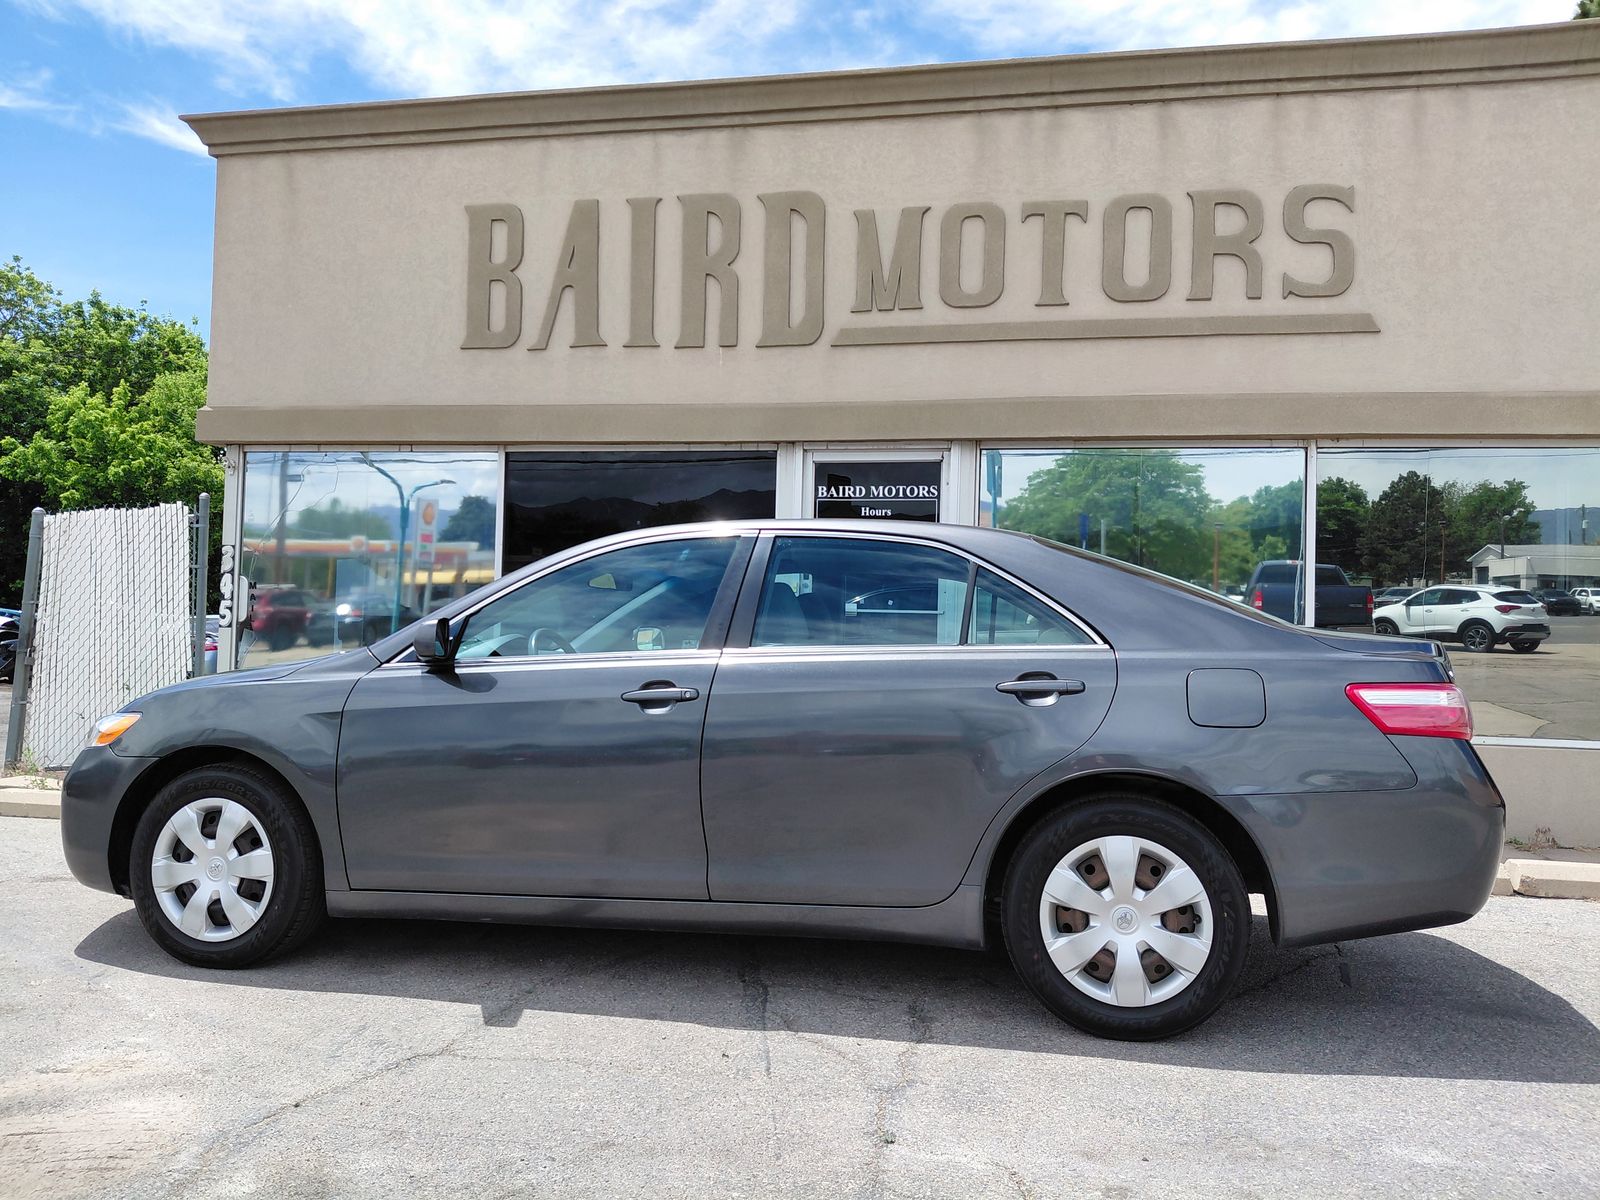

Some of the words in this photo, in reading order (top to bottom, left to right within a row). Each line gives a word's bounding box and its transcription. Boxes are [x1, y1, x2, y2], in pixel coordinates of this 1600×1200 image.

[460, 190, 826, 351] BAIRD
[850, 183, 1356, 313] MOTORS
[817, 485, 866, 498] BAIRD
[870, 485, 938, 498] MOTORS
[861, 506, 892, 517] Hours
[219, 545, 234, 627] 345
[249, 581, 257, 623] MAIL
